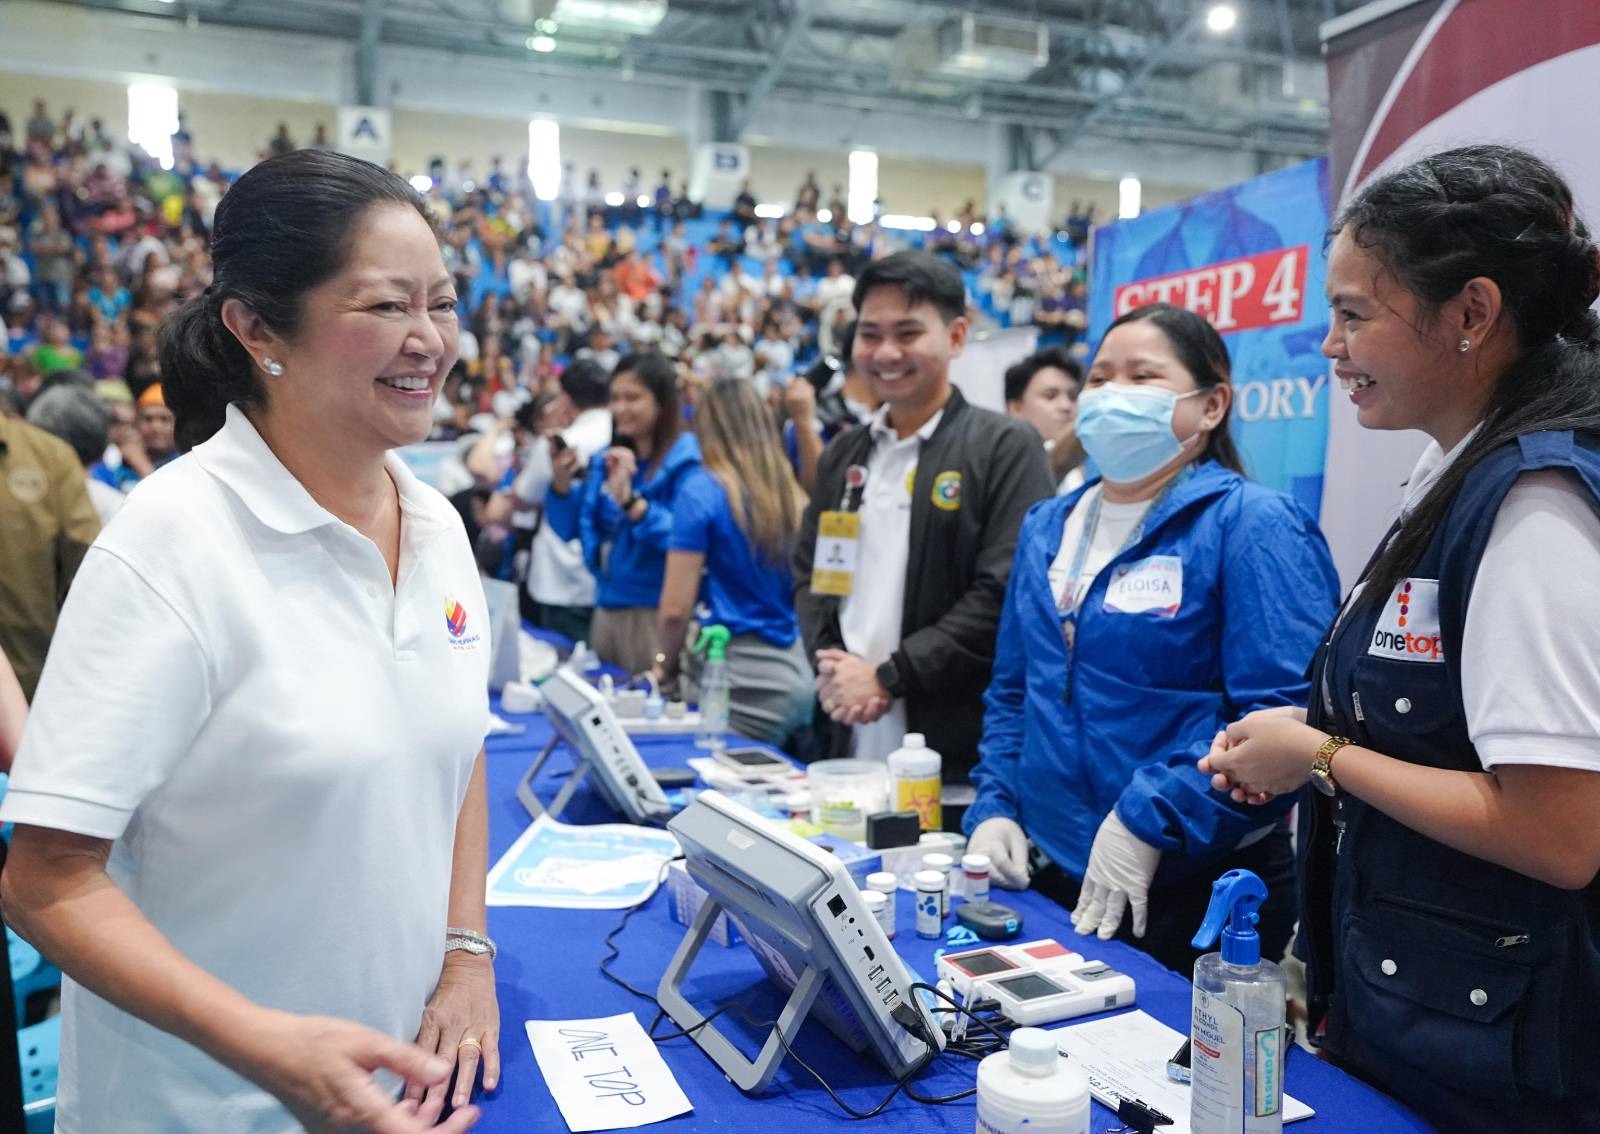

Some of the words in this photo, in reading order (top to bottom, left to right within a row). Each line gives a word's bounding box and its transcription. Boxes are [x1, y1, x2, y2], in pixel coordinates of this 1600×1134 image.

[352, 117, 378, 139] A
[1262, 251, 1300, 321] 4
[1231, 374, 1326, 422] ORY
[1119, 579, 1172, 593] ELOISA
[1195, 1007, 1218, 1026] ETHYL
[558, 1028, 618, 1062] ONE
[1200, 1029, 1226, 1044] MIGUEL
[584, 1065, 646, 1106] TOP
